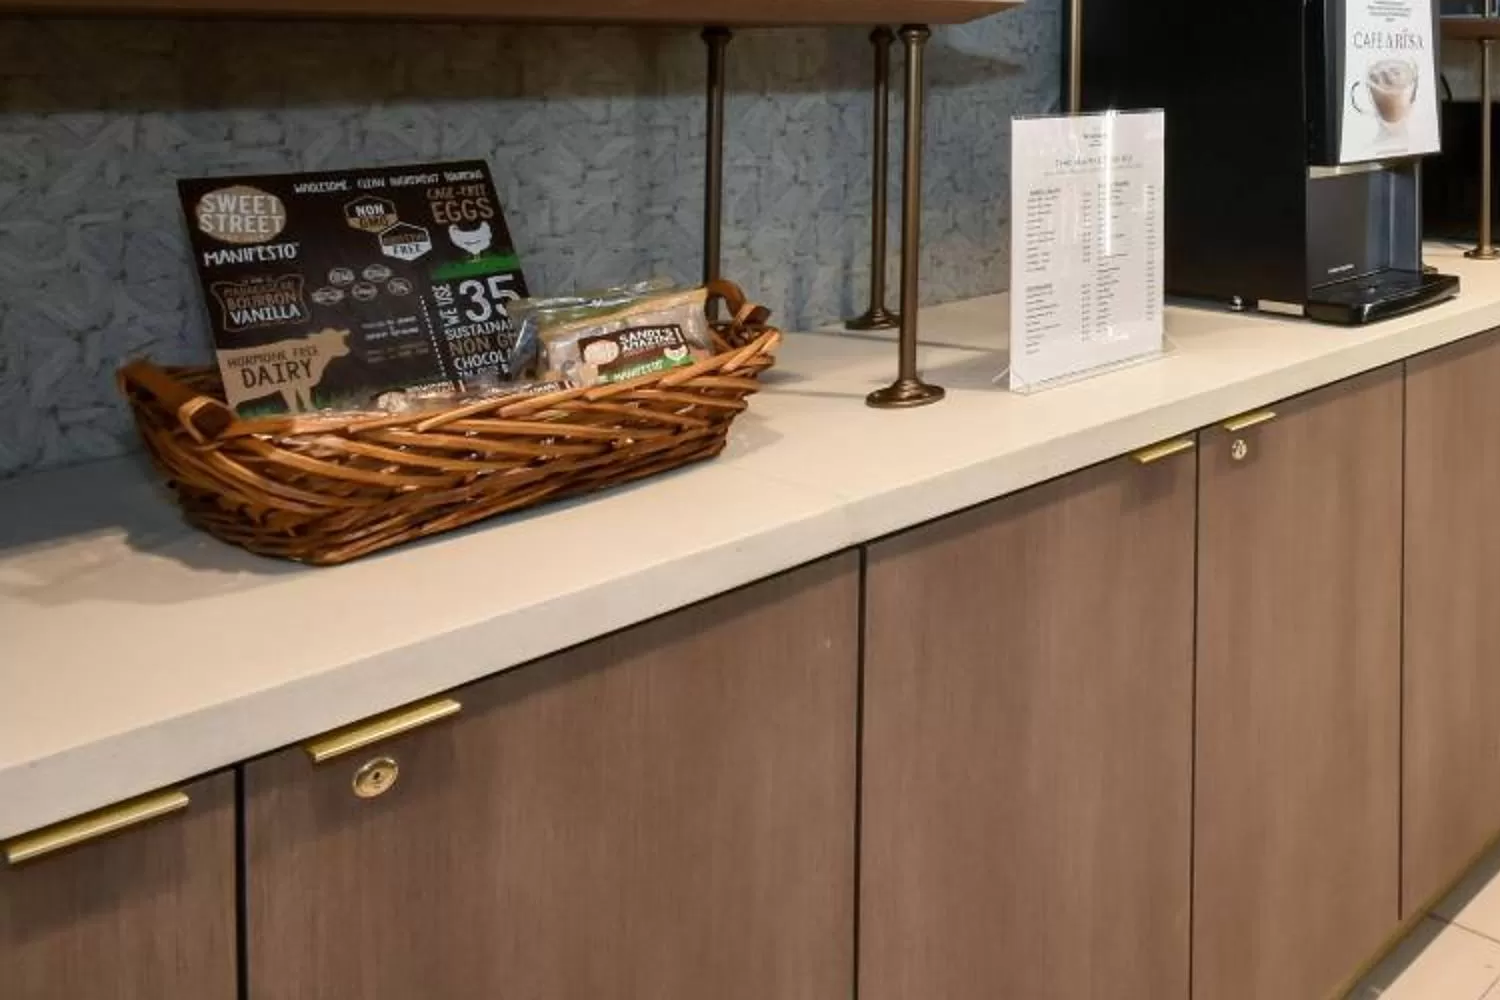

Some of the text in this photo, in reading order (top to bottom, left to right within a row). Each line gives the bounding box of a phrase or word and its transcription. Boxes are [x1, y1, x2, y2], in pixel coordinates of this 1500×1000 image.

[200, 193, 281, 214] SWEET
[355, 203, 385, 217] NON
[431, 197, 494, 224] EGGS
[200, 213, 283, 233] STREET
[203, 243, 297, 268] MANIFESTO
[460, 274, 520, 323] 35
[230, 304, 301, 325] VANILLA
[444, 319, 514, 341] SUSTAINA
[449, 335, 492, 356] NON
[241, 358, 312, 389] DAIRY
